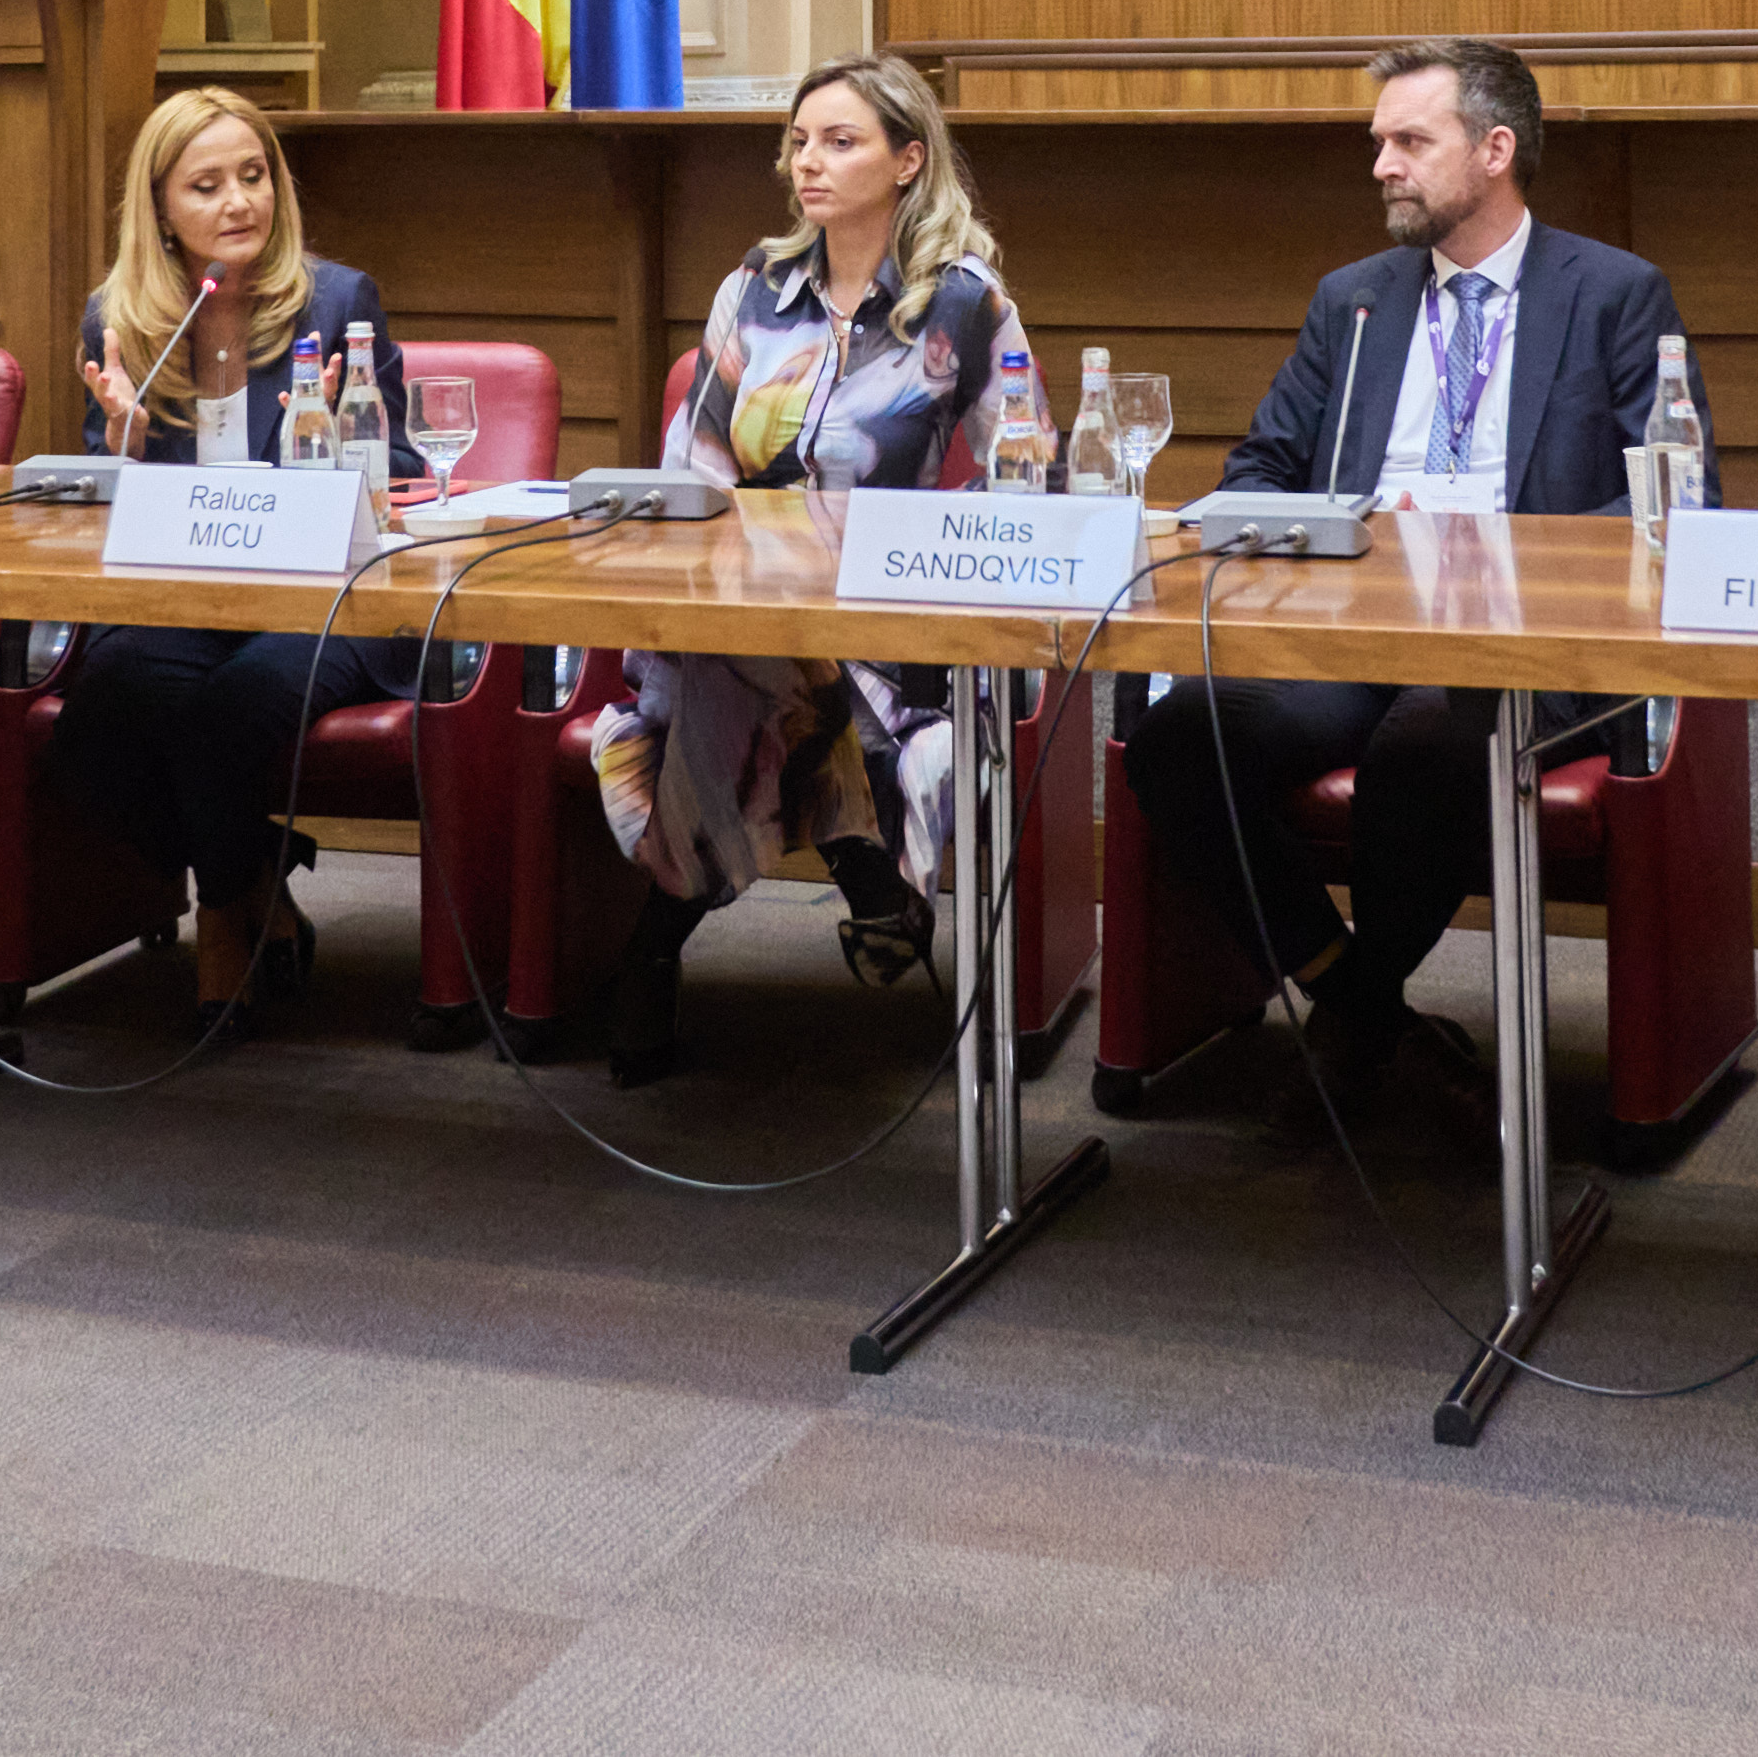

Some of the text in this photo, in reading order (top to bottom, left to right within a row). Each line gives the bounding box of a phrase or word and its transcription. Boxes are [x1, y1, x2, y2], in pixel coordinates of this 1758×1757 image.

[189, 485, 277, 512] Raluca
[189, 521, 263, 548] MICU
[942, 513, 1033, 543] Niklas
[884, 550, 1084, 585] SANDQVIST
